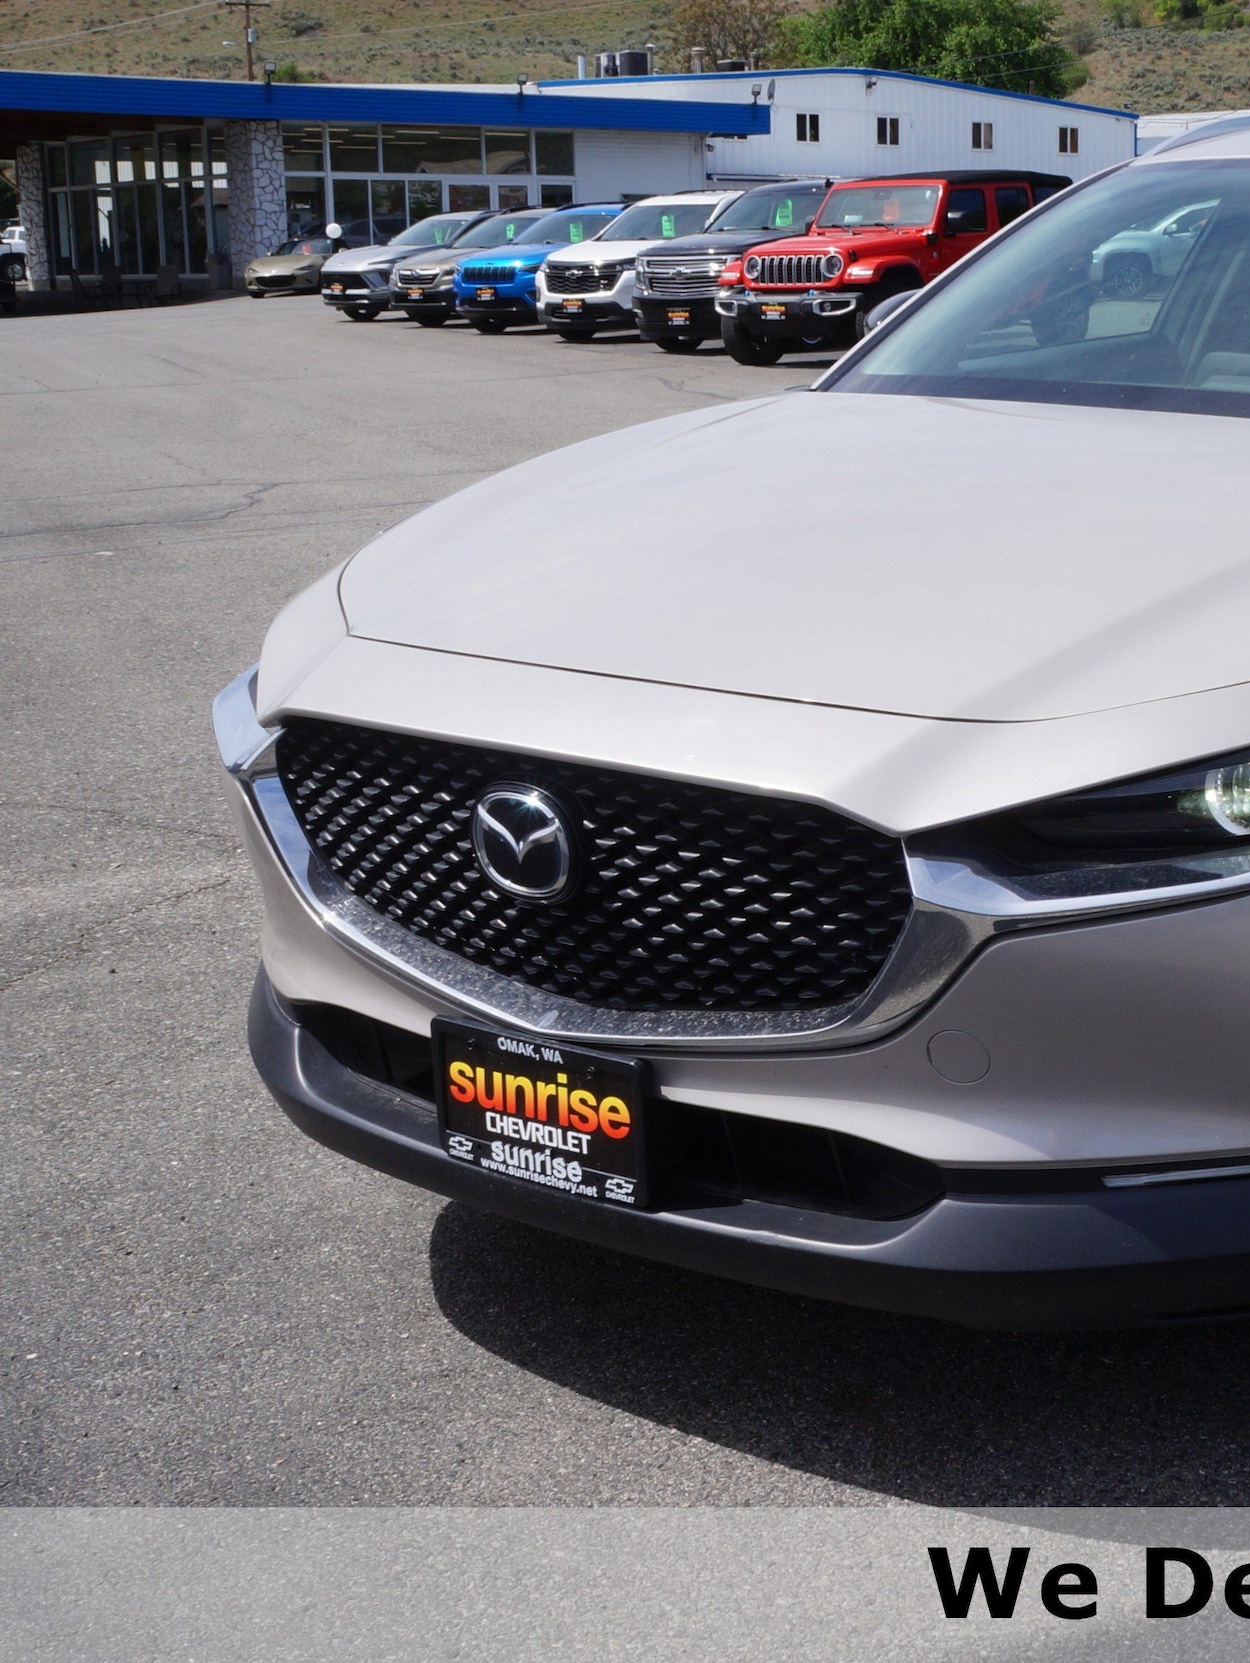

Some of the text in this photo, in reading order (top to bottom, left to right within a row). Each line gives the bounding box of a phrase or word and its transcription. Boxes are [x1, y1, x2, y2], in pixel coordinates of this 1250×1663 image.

[497, 1036, 563, 1064] OMAK, WA
[449, 1061, 630, 1139] sunrise
[485, 1111, 591, 1155] CHEVROLET
[480, 1157, 598, 1198] www.sunrisechevy.net
[490, 1140, 583, 1183] sunrise
